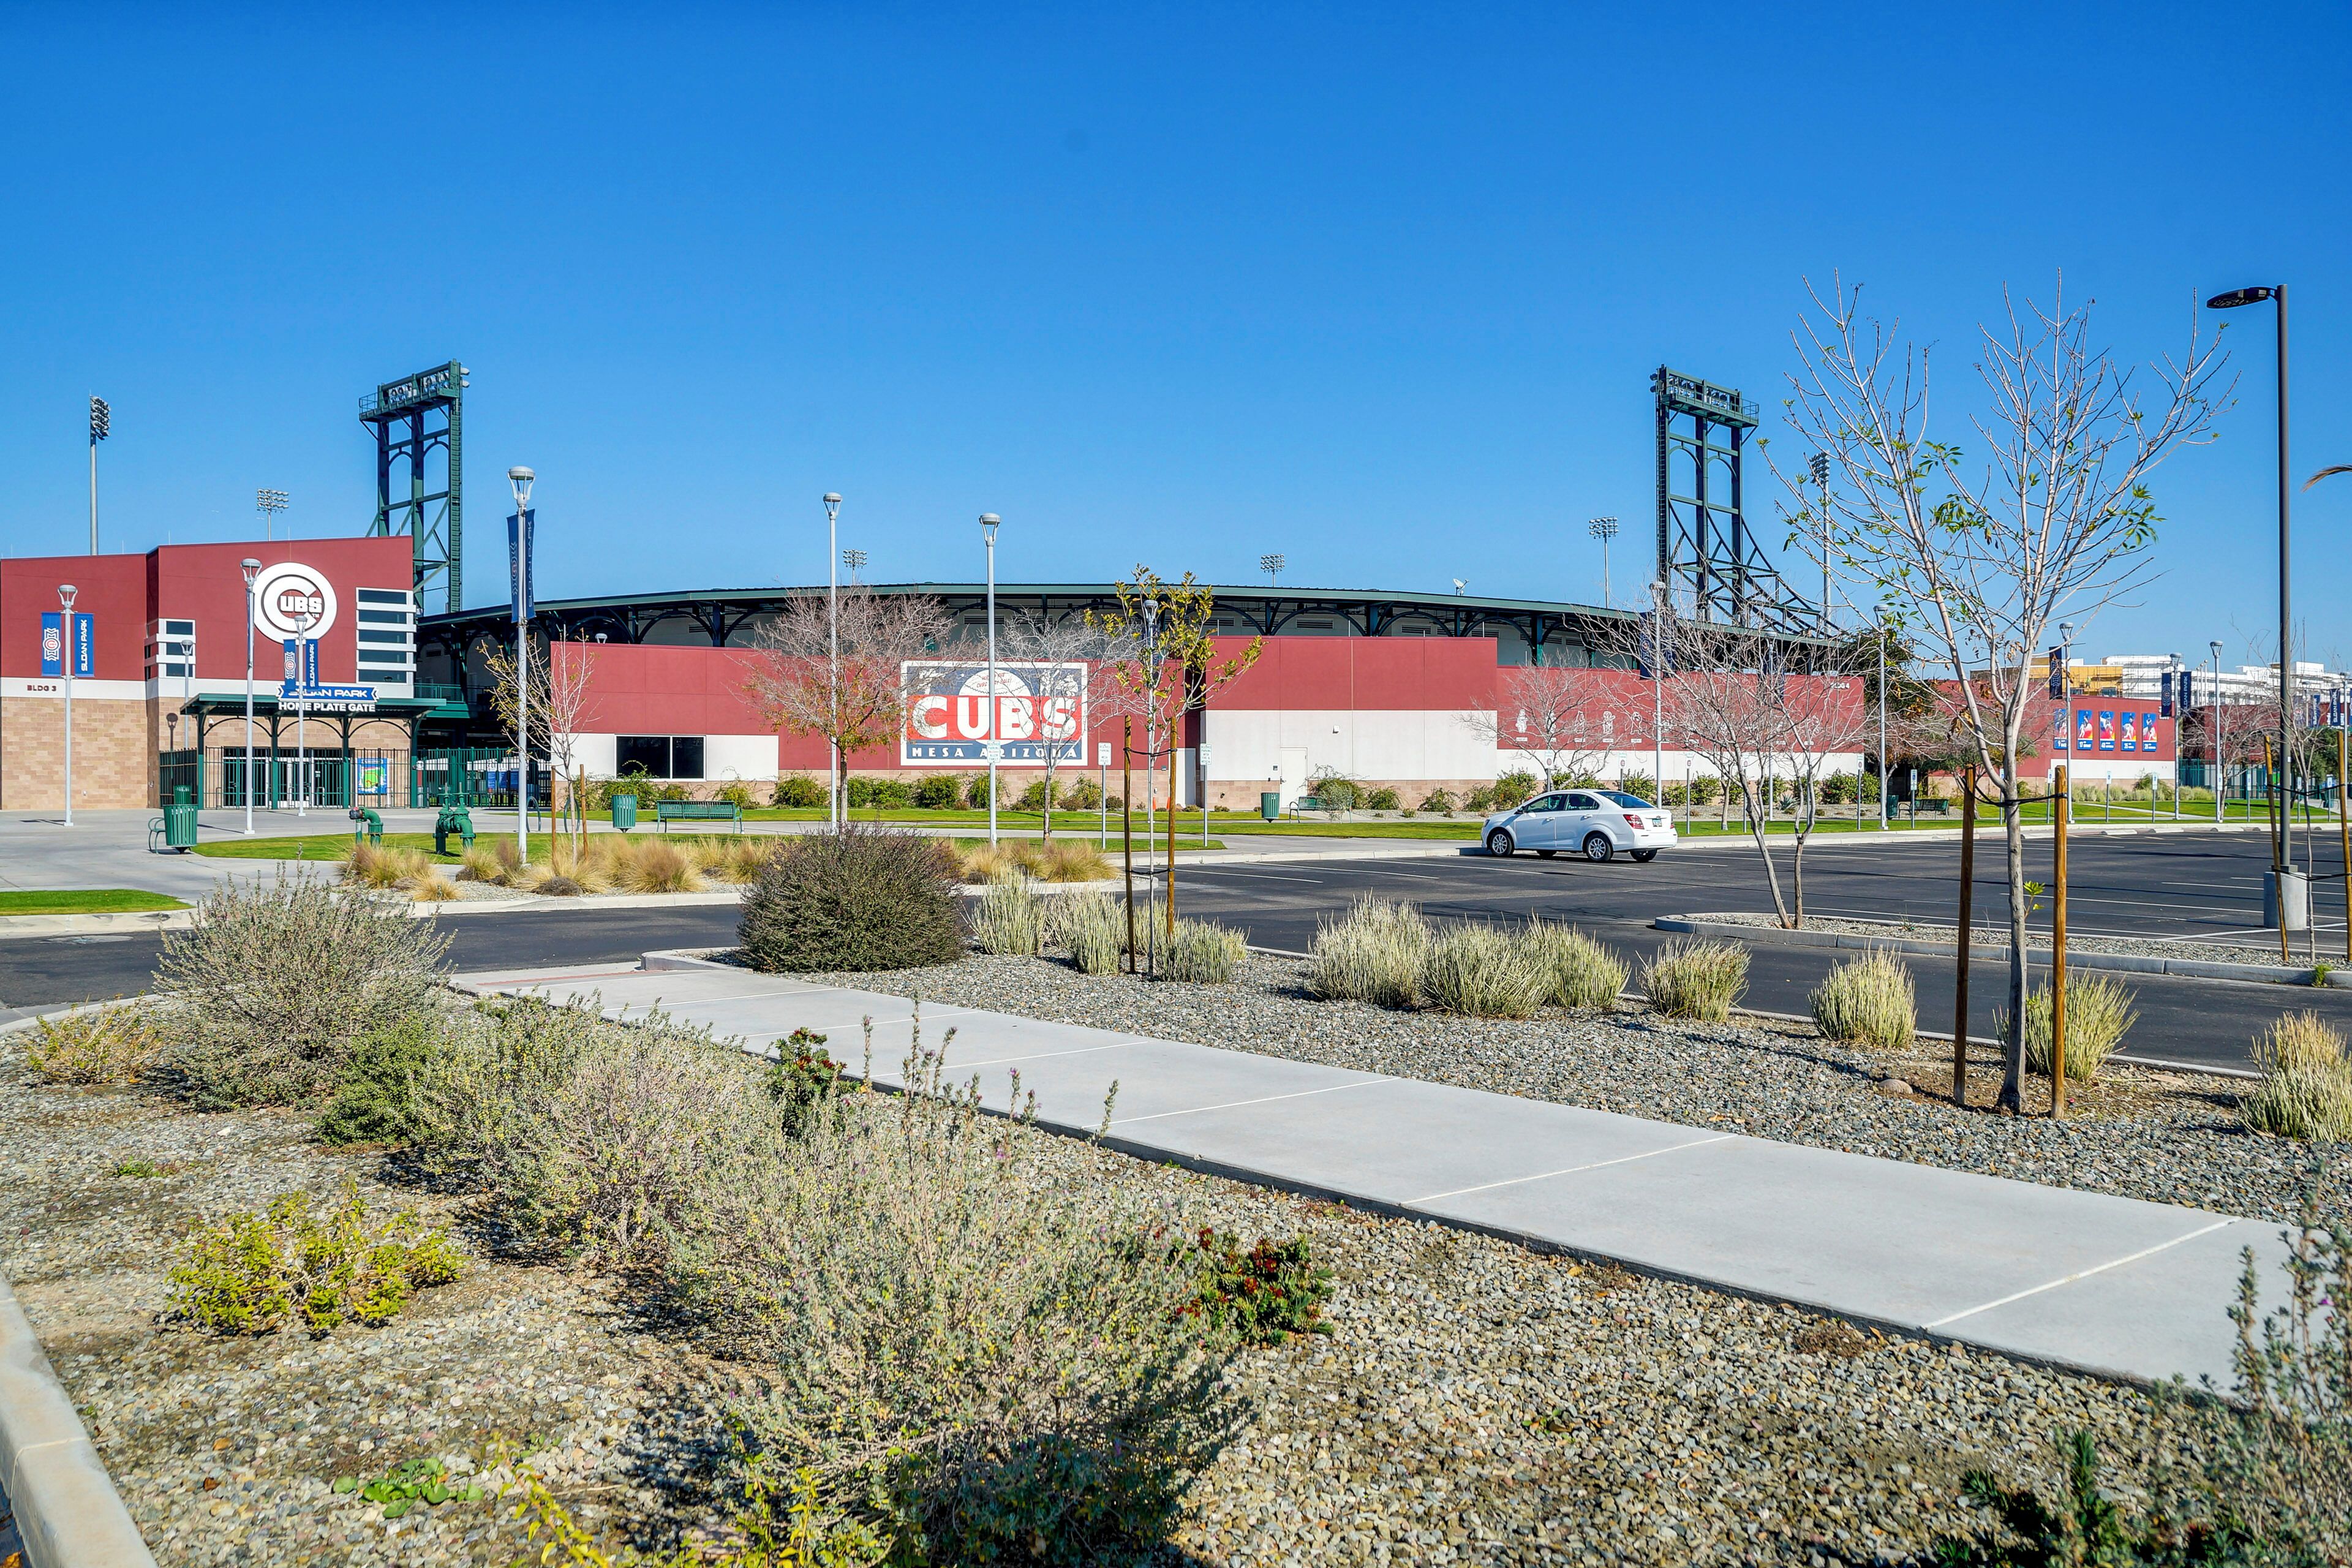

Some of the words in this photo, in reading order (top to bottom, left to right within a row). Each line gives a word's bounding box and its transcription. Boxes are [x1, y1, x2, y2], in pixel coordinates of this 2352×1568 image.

[263, 576, 322, 631] CUBS
[279, 702, 312, 710] HOME
[314, 703, 347, 712] PLATE
[912, 695, 1076, 739] CUBS
[912, 747, 964, 757] MESA
